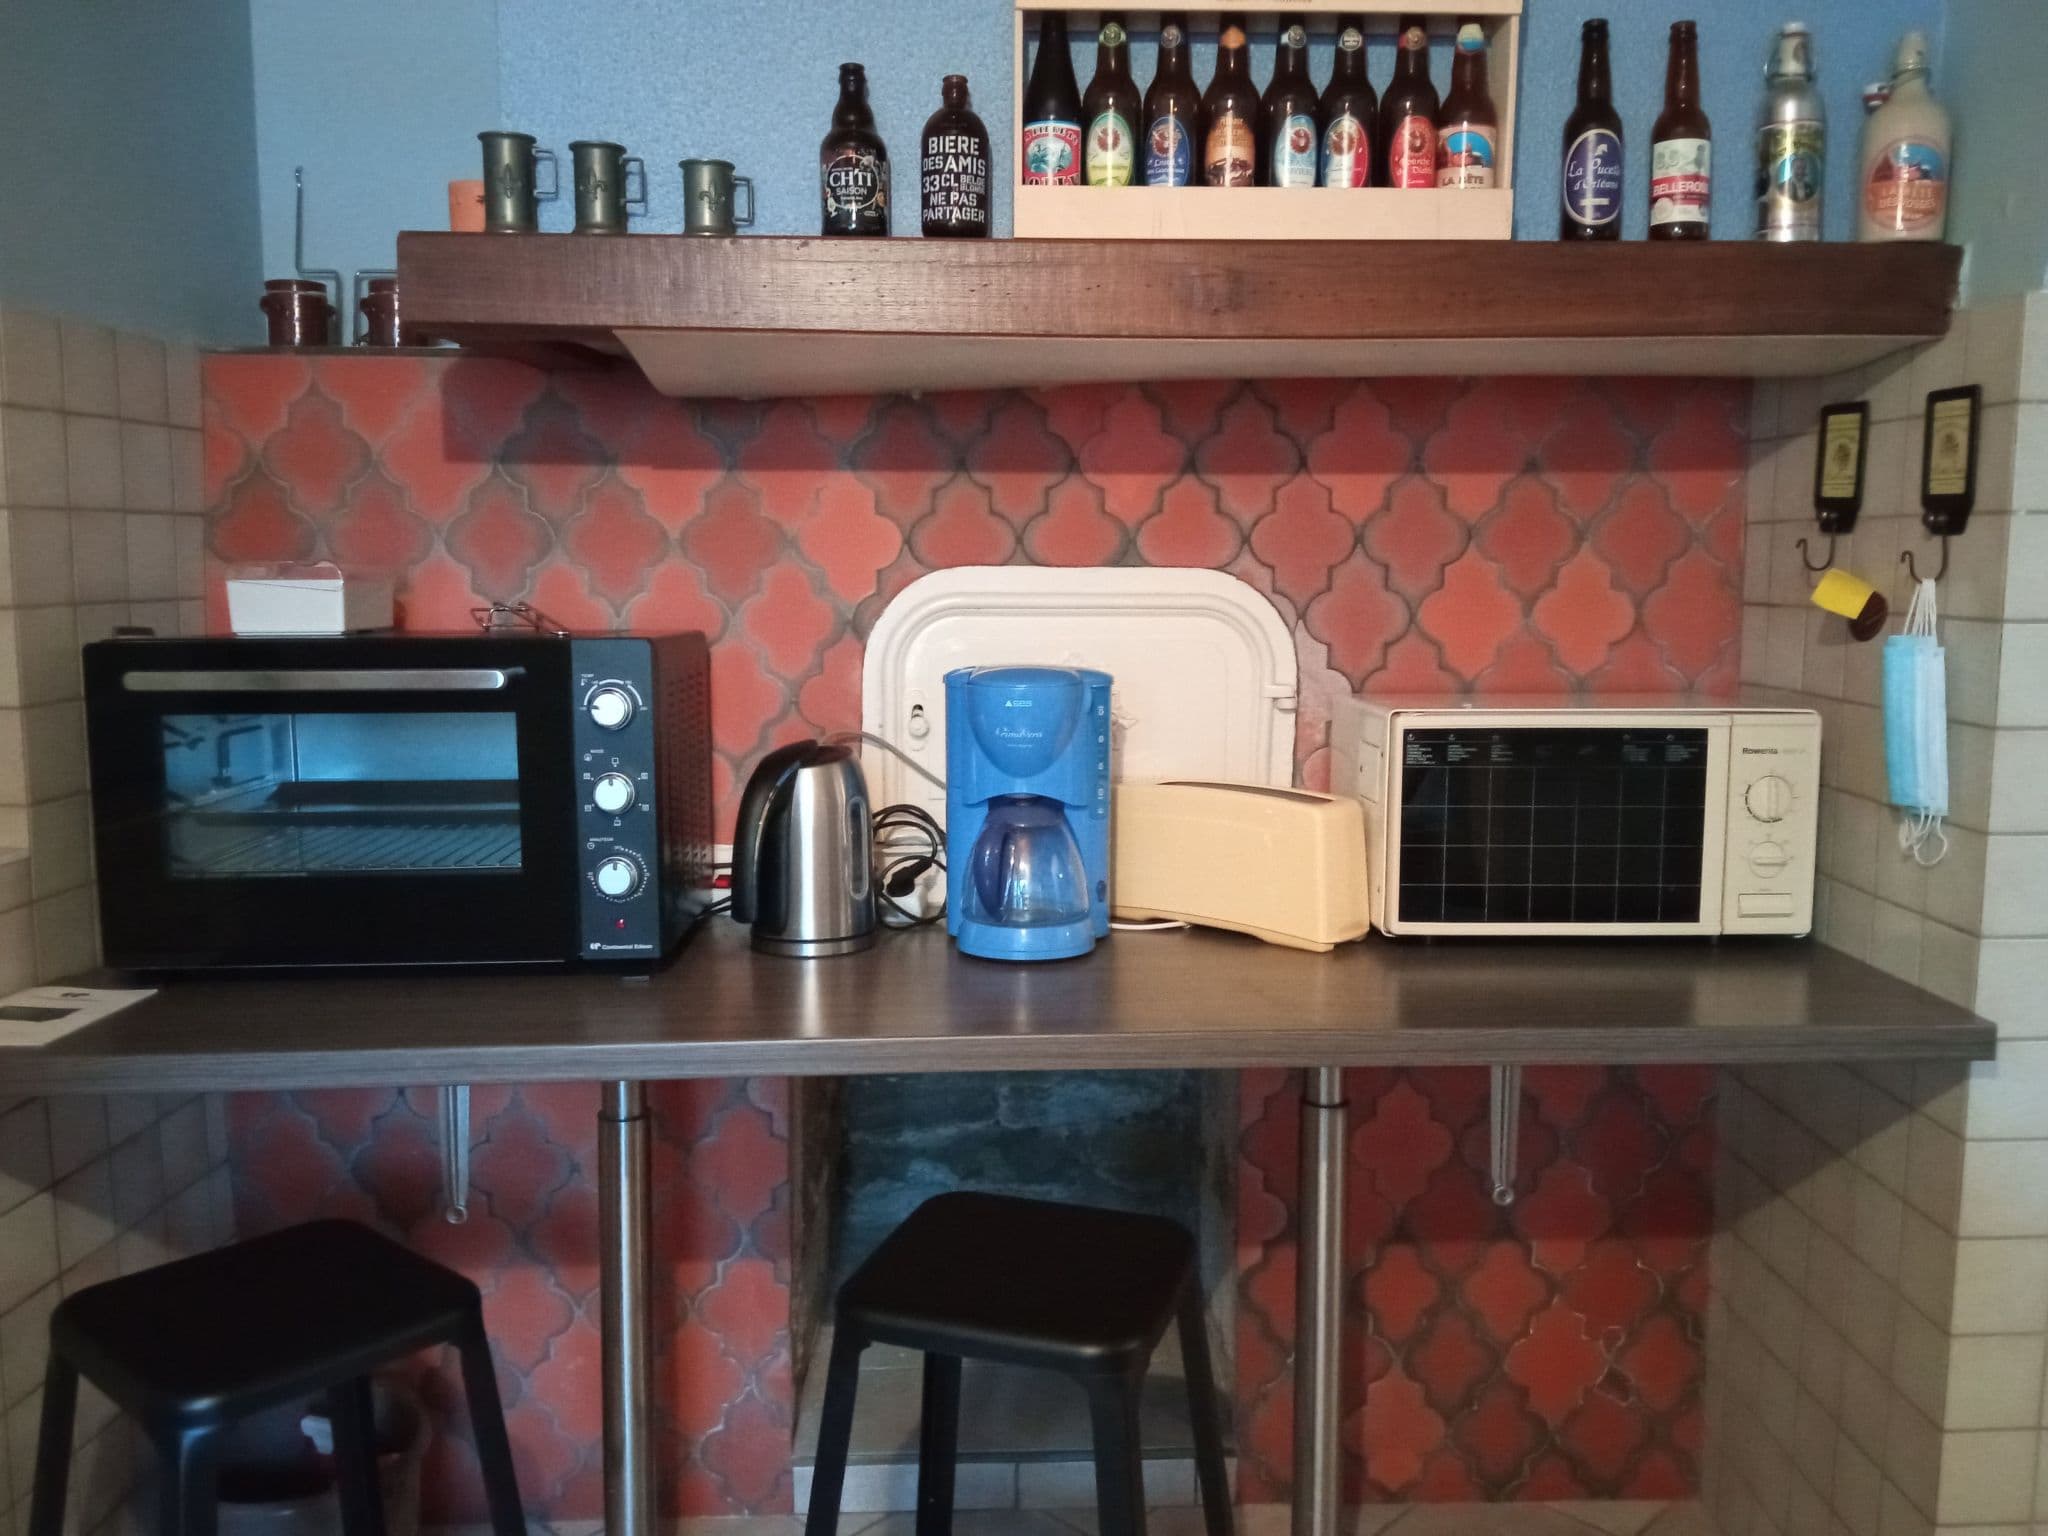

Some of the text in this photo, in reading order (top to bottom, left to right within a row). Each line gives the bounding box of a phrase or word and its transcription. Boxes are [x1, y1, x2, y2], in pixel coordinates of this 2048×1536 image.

[928, 135, 980, 155] BIERE
[923, 154, 986, 177] DES AMIS
[836, 186, 868, 196] SAISON
[929, 192, 977, 207] NE PAS
[922, 207, 985, 224] PARTAGER
